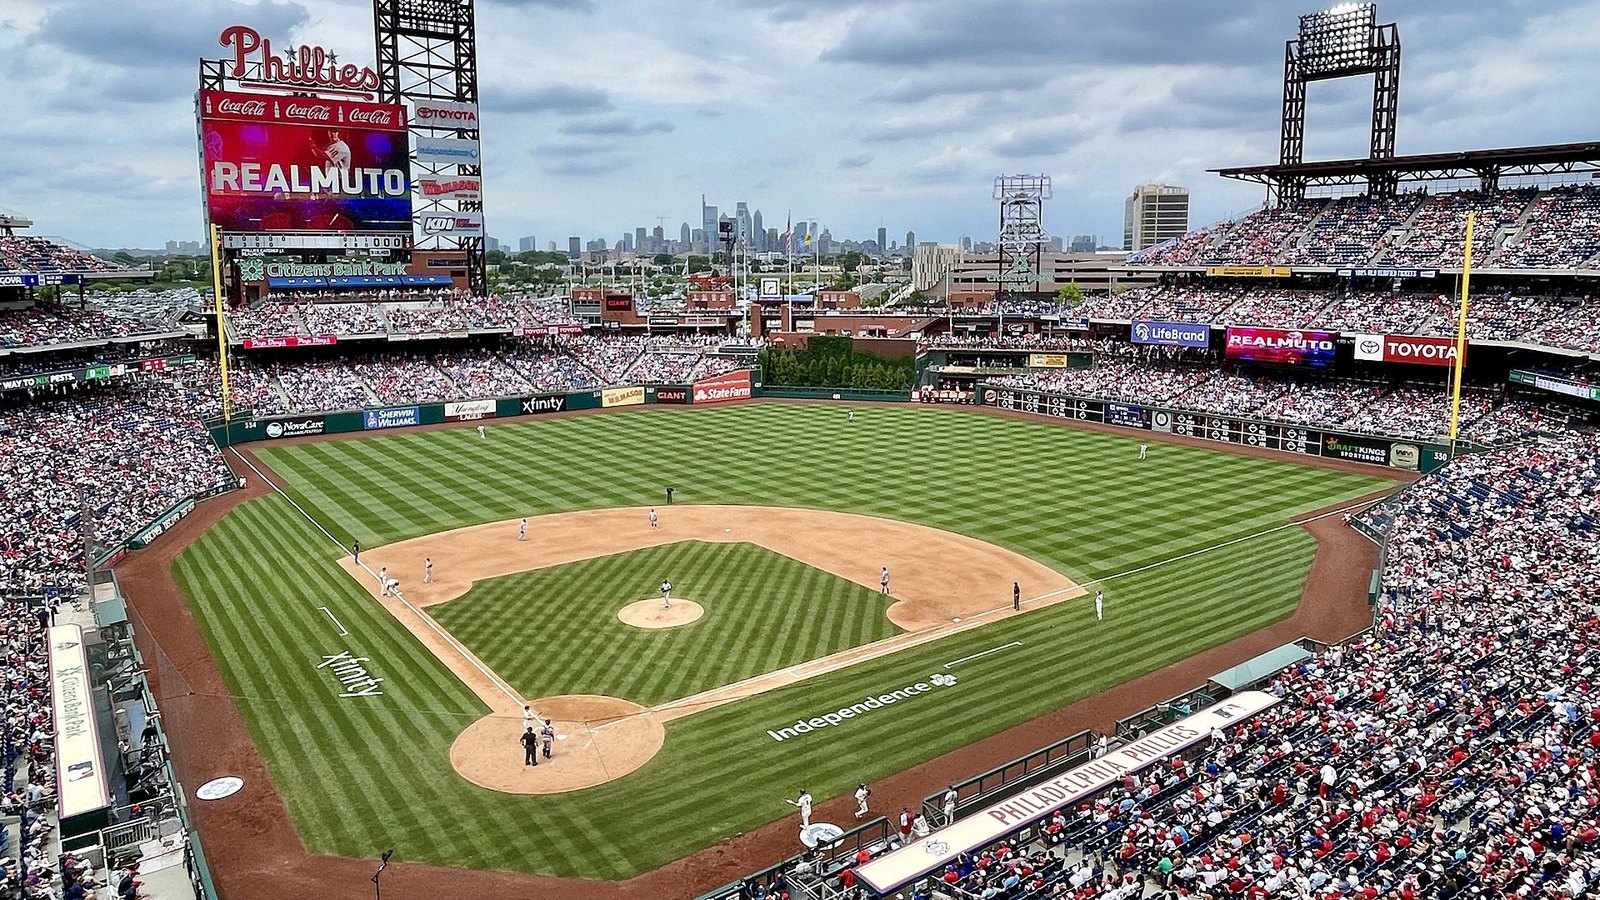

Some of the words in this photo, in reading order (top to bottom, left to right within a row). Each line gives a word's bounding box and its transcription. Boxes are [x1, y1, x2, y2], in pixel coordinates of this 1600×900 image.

[219, 25, 380, 91] Phillies
[218, 98, 266, 116] Coca-Cola
[286, 103, 331, 120] Coca-Cola
[432, 109, 476, 121] TOYOTA
[349, 108, 392, 124] Coca-Cola
[214, 161, 405, 196] REALMUTO
[424, 217, 456, 232] KDI
[374, 238, 380, 247] 0
[384, 238, 390, 247] 0
[394, 238, 400, 247] 0
[267, 262, 332, 277] Citizens
[333, 262, 373, 276] Bank
[374, 262, 407, 276] Park
[1152, 328, 1205, 342] LifeBrand
[1228, 335, 1333, 350] REALMUTO
[1387, 342, 1458, 359] TOYOTA
[2, 379, 22, 390] WAY
[23, 378, 34, 386] TO
[522, 396, 564, 414] xfinity
[378, 409, 414, 419] SHERWIN
[284, 420, 324, 431] NovaCare
[1327, 443, 1386, 456] DRAFTKINGS
[1340, 451, 1385, 462] SPORTSBOOK
[1434, 452, 1448, 461] 330
[316, 650, 384, 698] xfinity
[61, 676, 79, 703] Citizens
[64, 702, 86, 722] Bank
[766, 682, 932, 742] Independence
[65, 720, 88, 739] Park
[987, 759, 1129, 826] PHILADELPHIA
[1122, 725, 1200, 762] PHILLIES
